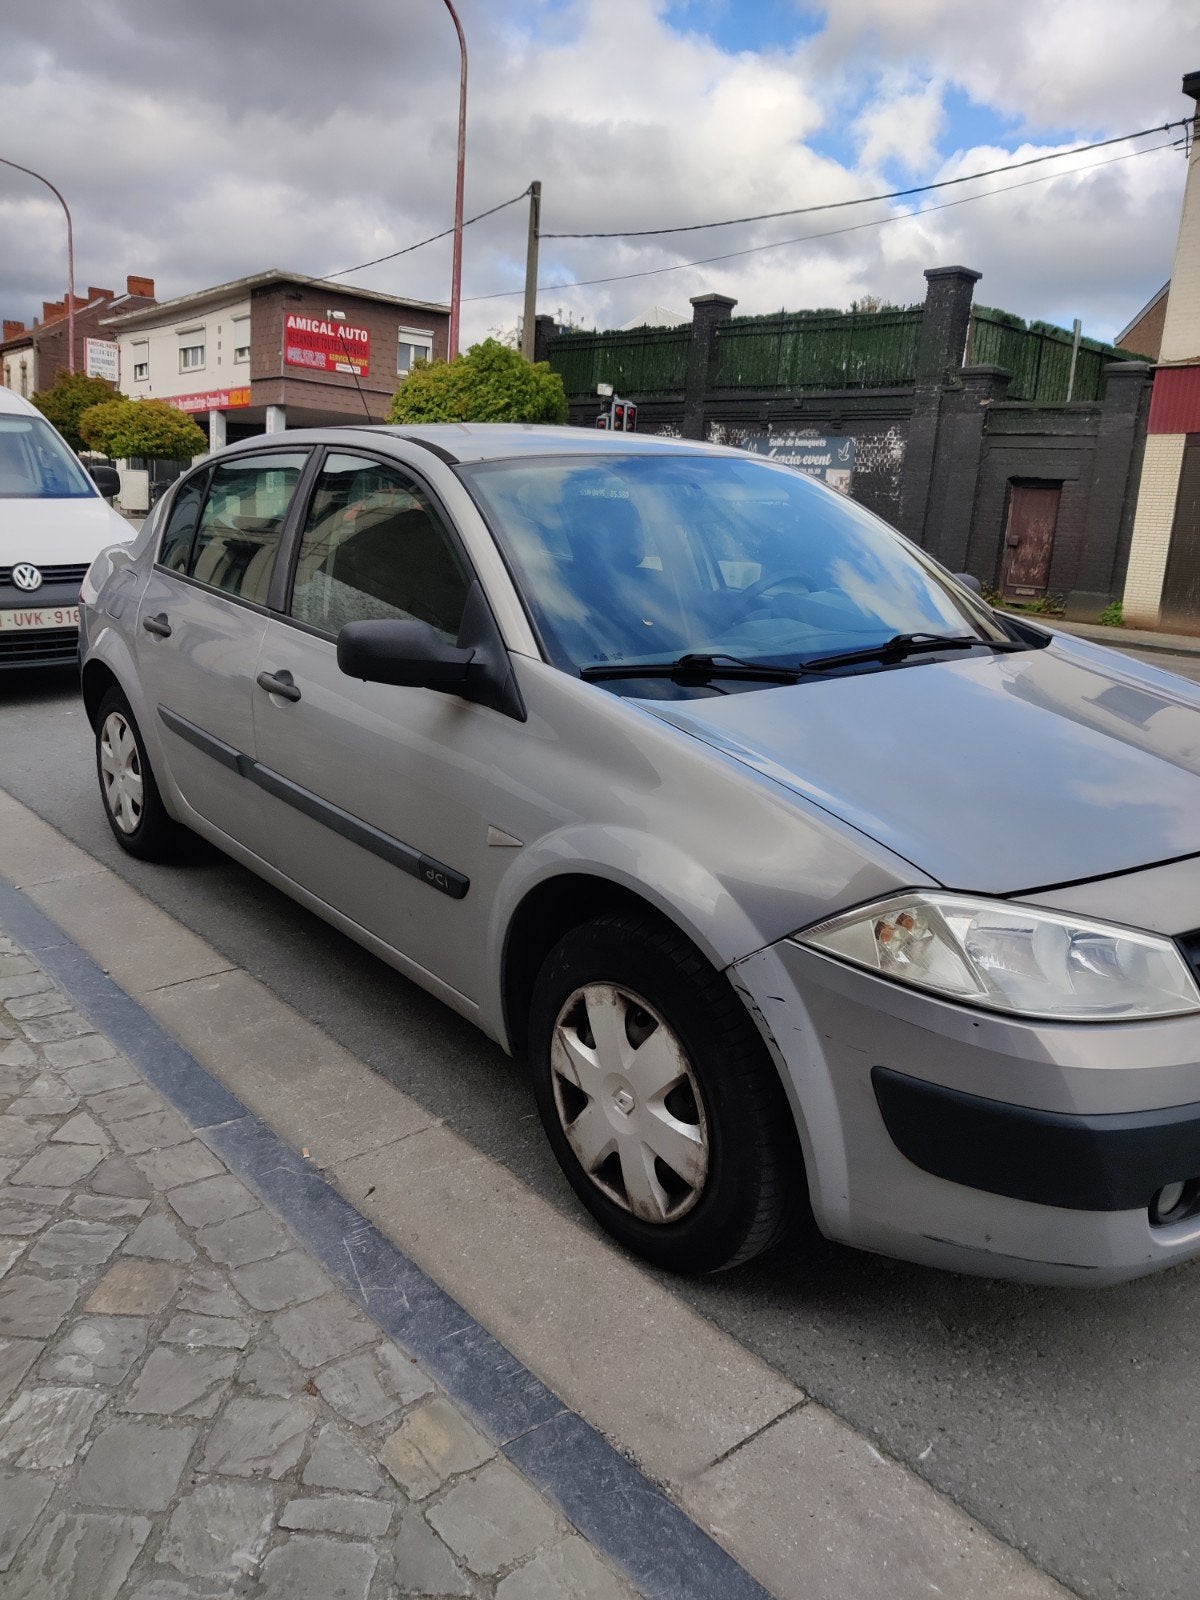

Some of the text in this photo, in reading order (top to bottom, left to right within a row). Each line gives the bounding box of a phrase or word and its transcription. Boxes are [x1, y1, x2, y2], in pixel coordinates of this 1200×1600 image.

[287, 315, 368, 343] AMICAL AUTO
[321, 338, 340, 352] TOUTES
[769, 438, 827, 448] Salle de banquets
[803, 454, 832, 465] event
